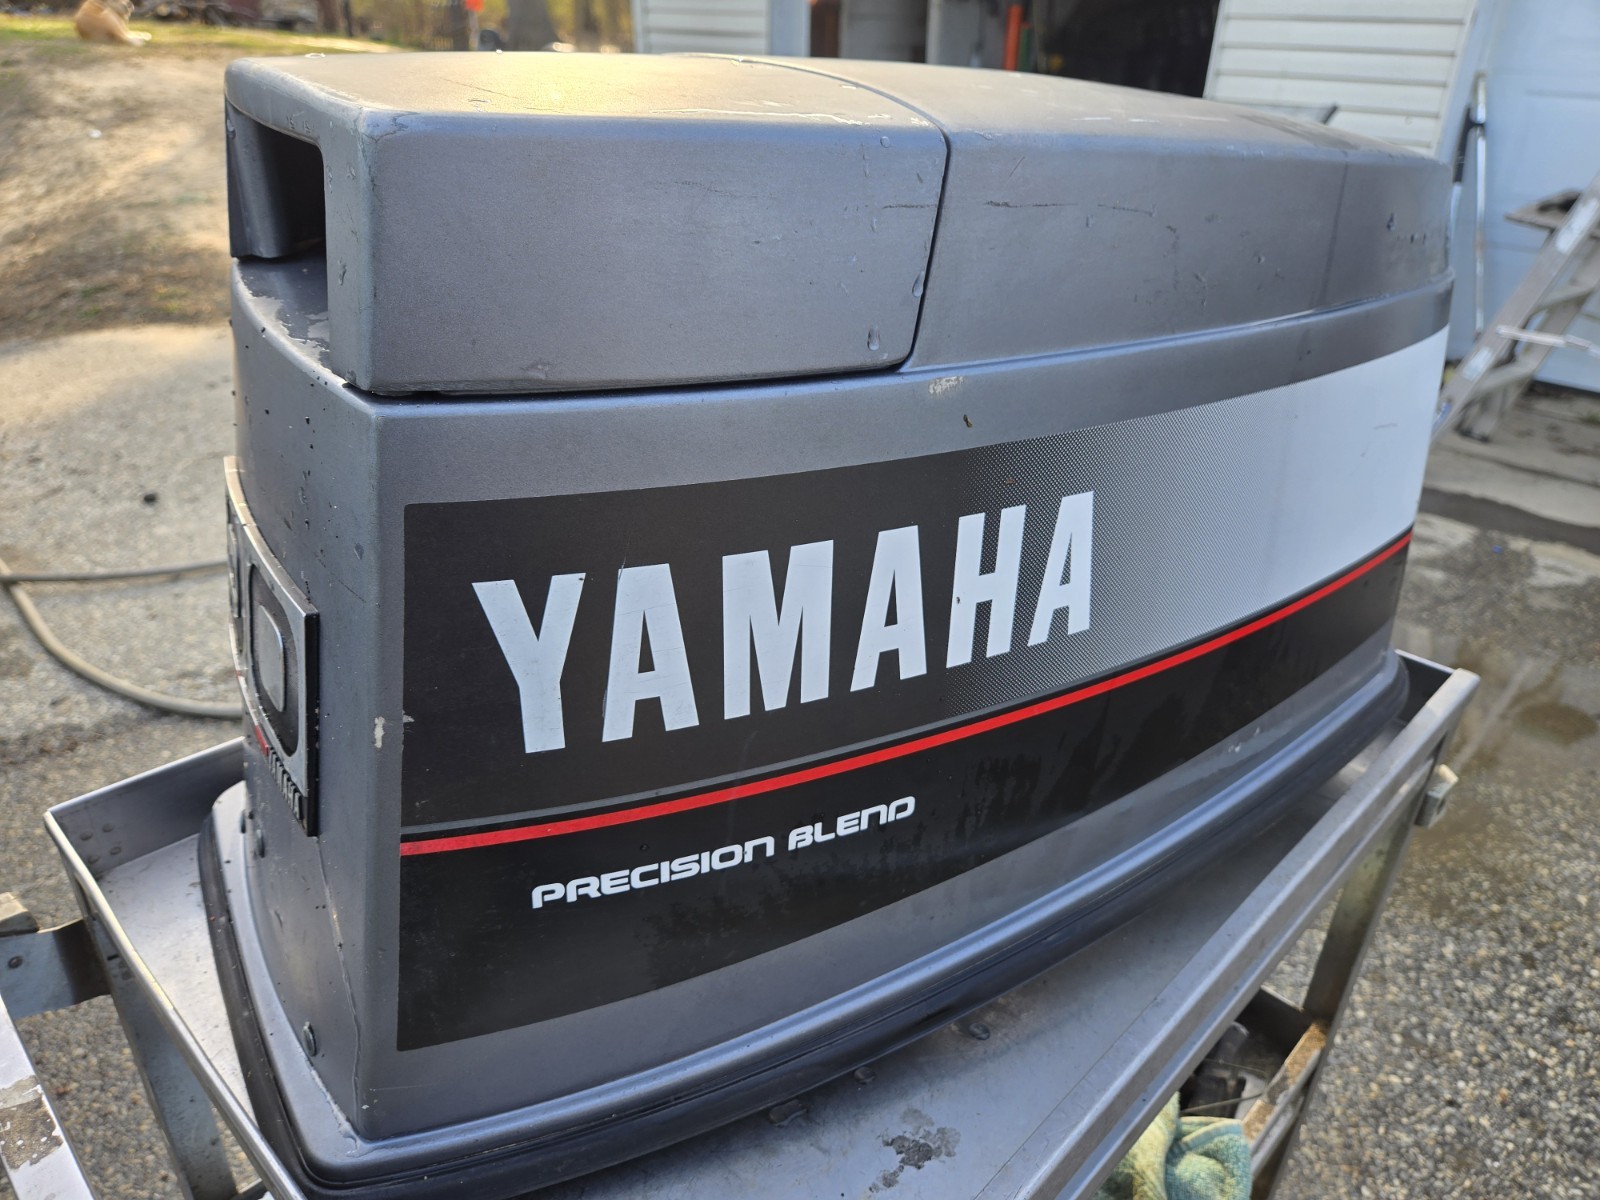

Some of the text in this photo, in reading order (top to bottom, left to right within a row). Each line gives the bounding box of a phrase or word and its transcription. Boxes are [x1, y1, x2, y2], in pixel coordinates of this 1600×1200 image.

[472, 490, 1094, 753] YAMAHA
[531, 795, 916, 908] PRECISION BLEND
